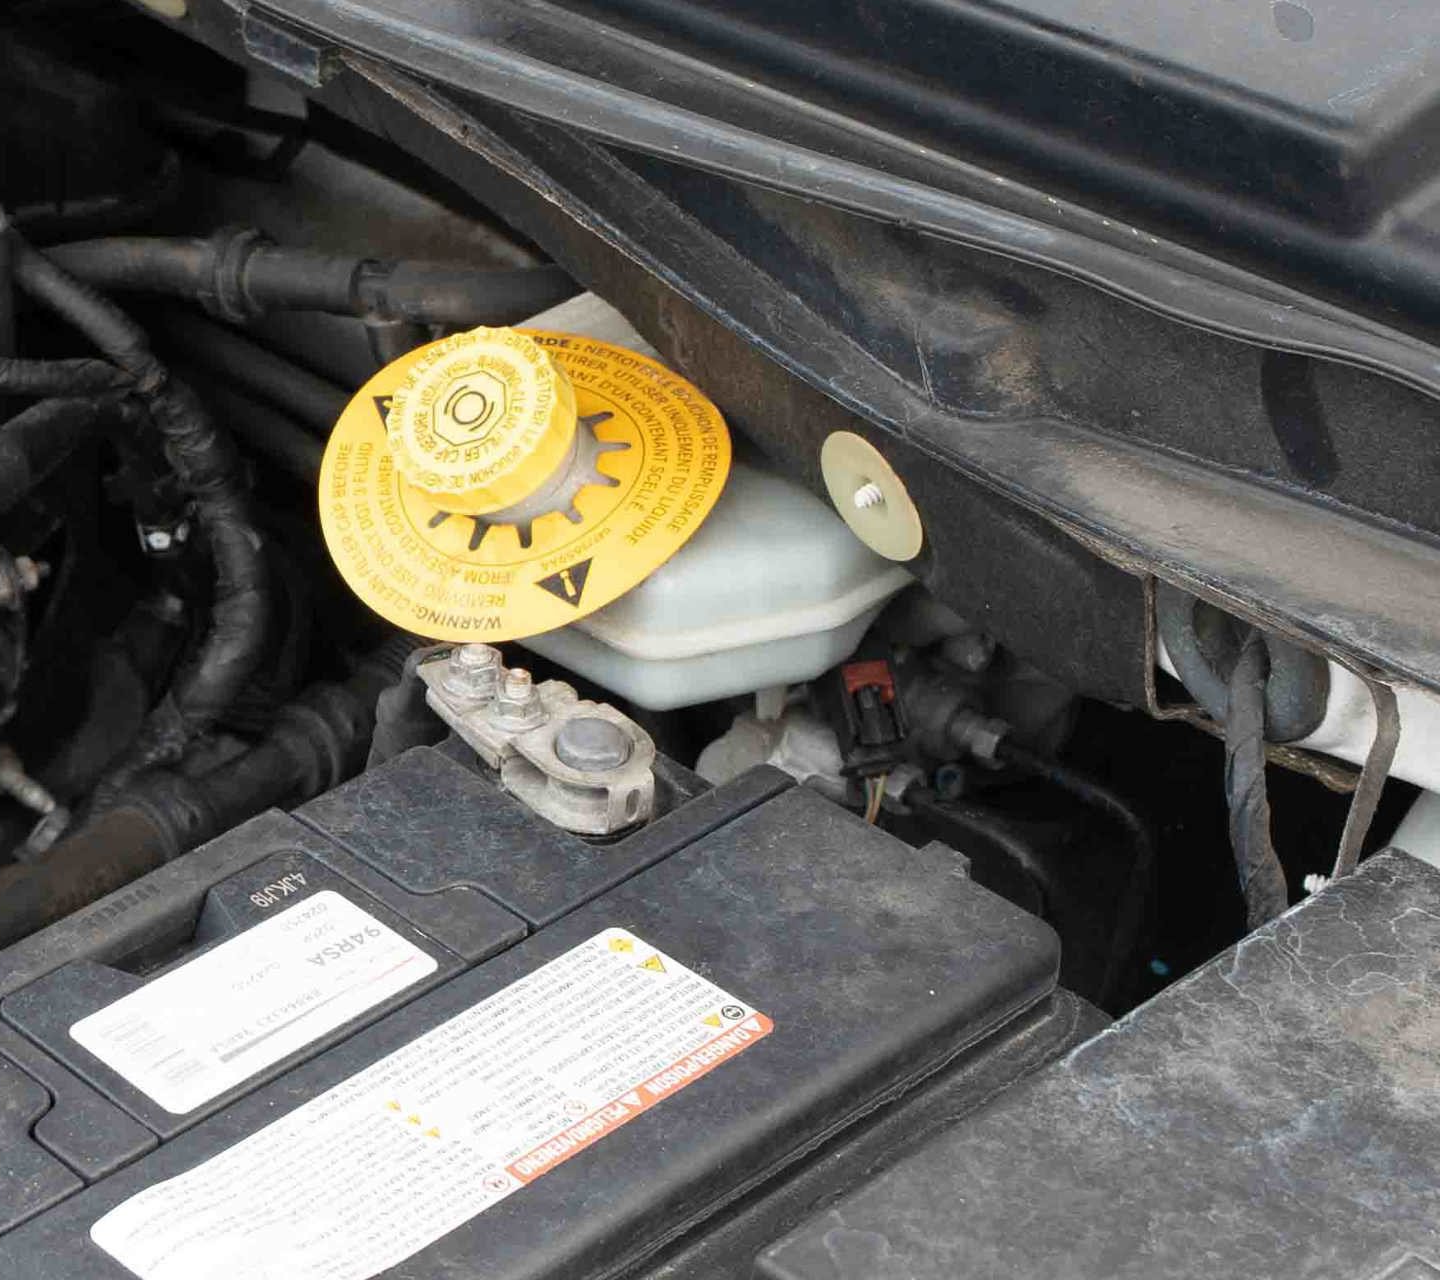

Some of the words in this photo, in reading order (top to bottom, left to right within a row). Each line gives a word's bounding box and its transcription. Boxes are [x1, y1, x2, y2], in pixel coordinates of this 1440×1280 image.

[629, 398, 668, 464] CONTENANT
[661, 401, 691, 473] UNIQUEMENT
[702, 435, 718, 451] DE
[330, 440, 354, 499] BEFORE
[351, 439, 375, 483] FLUID
[664, 475, 687, 493] DU
[330, 502, 352, 532] CAP
[354, 502, 375, 531] DOT
[663, 453, 716, 533] REMPLISSAGE
[620, 496, 678, 546] LIQUIDE
[407, 603, 503, 630] WARNING:
[642, 1028, 753, 1096] DANGER/POISON
[512, 1099, 630, 1177] PELIGRO/VENENO
